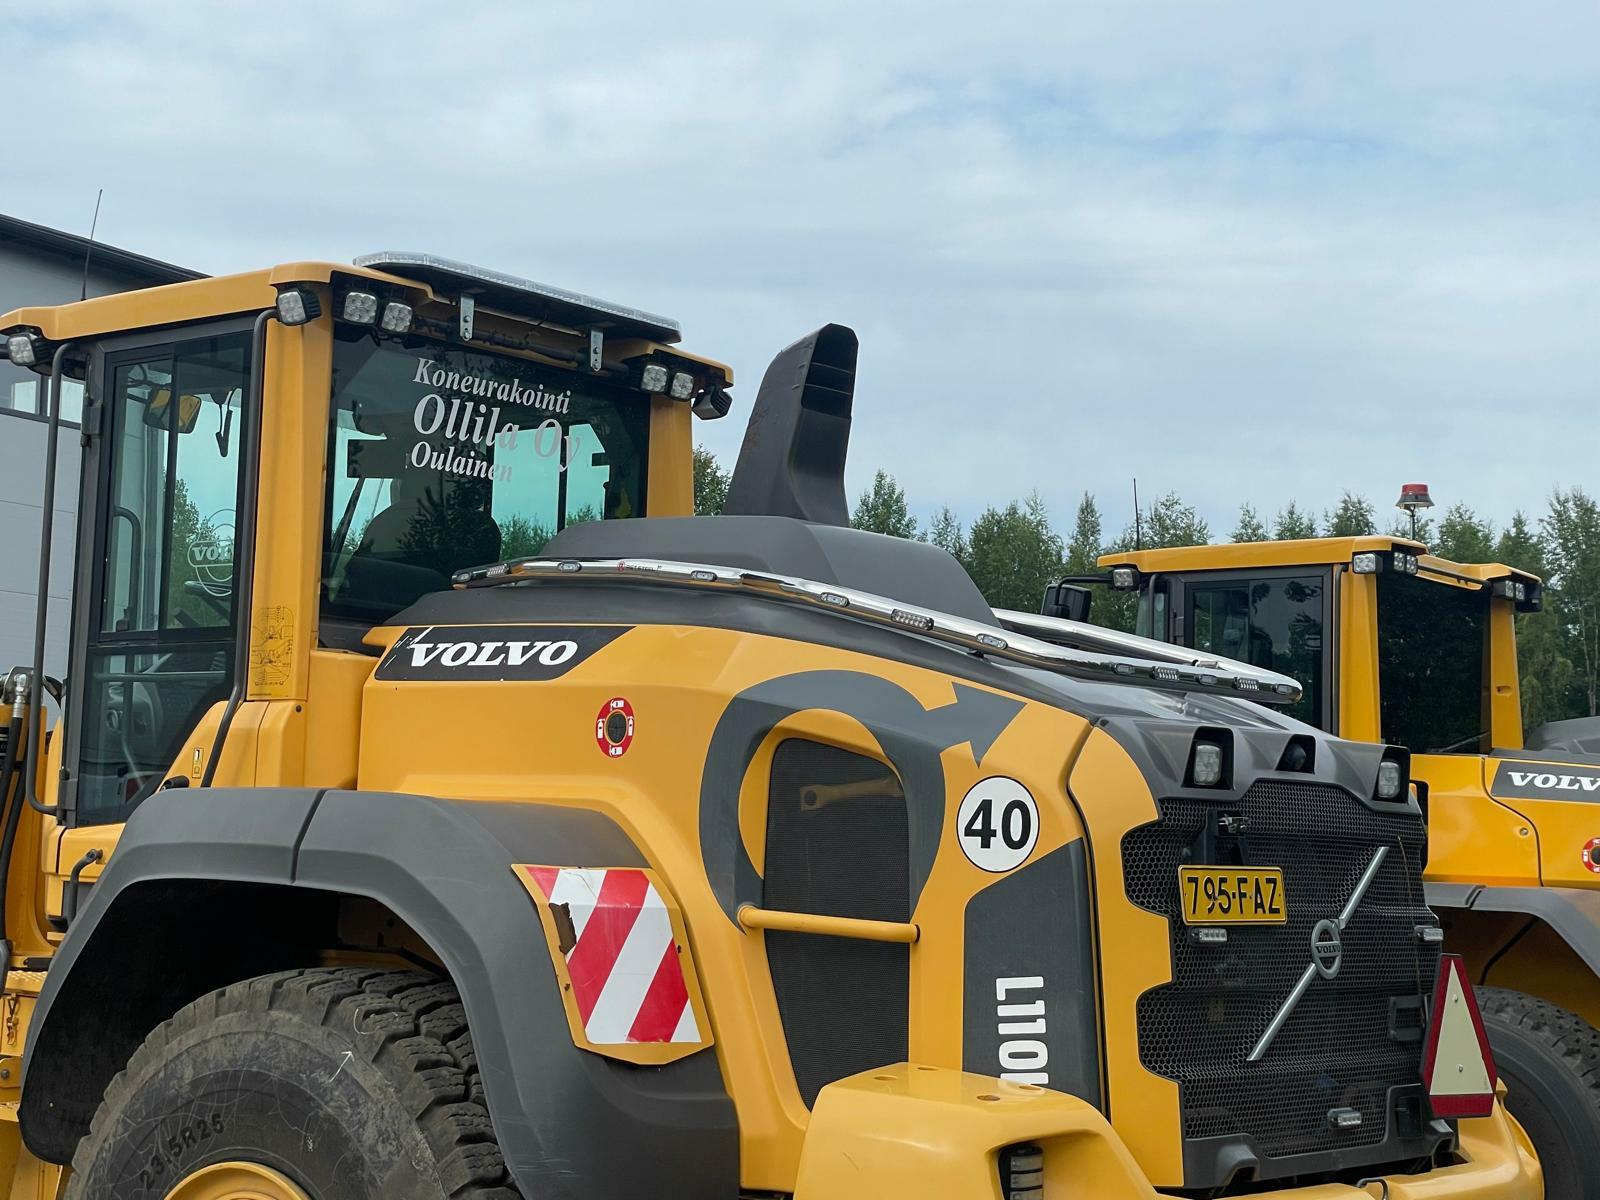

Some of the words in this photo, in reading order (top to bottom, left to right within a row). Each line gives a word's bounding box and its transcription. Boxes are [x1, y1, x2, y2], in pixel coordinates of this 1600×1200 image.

[412, 357, 572, 414] Koneurakointi
[413, 393, 520, 447] Ollila
[534, 418, 581, 473] Oy
[410, 441, 513, 482] Oulainen
[410, 640, 579, 667] VOLVO
[1507, 771, 1600, 791] VOLV
[964, 799, 1031, 850] 40
[1187, 876, 1281, 915] 795-FAZ
